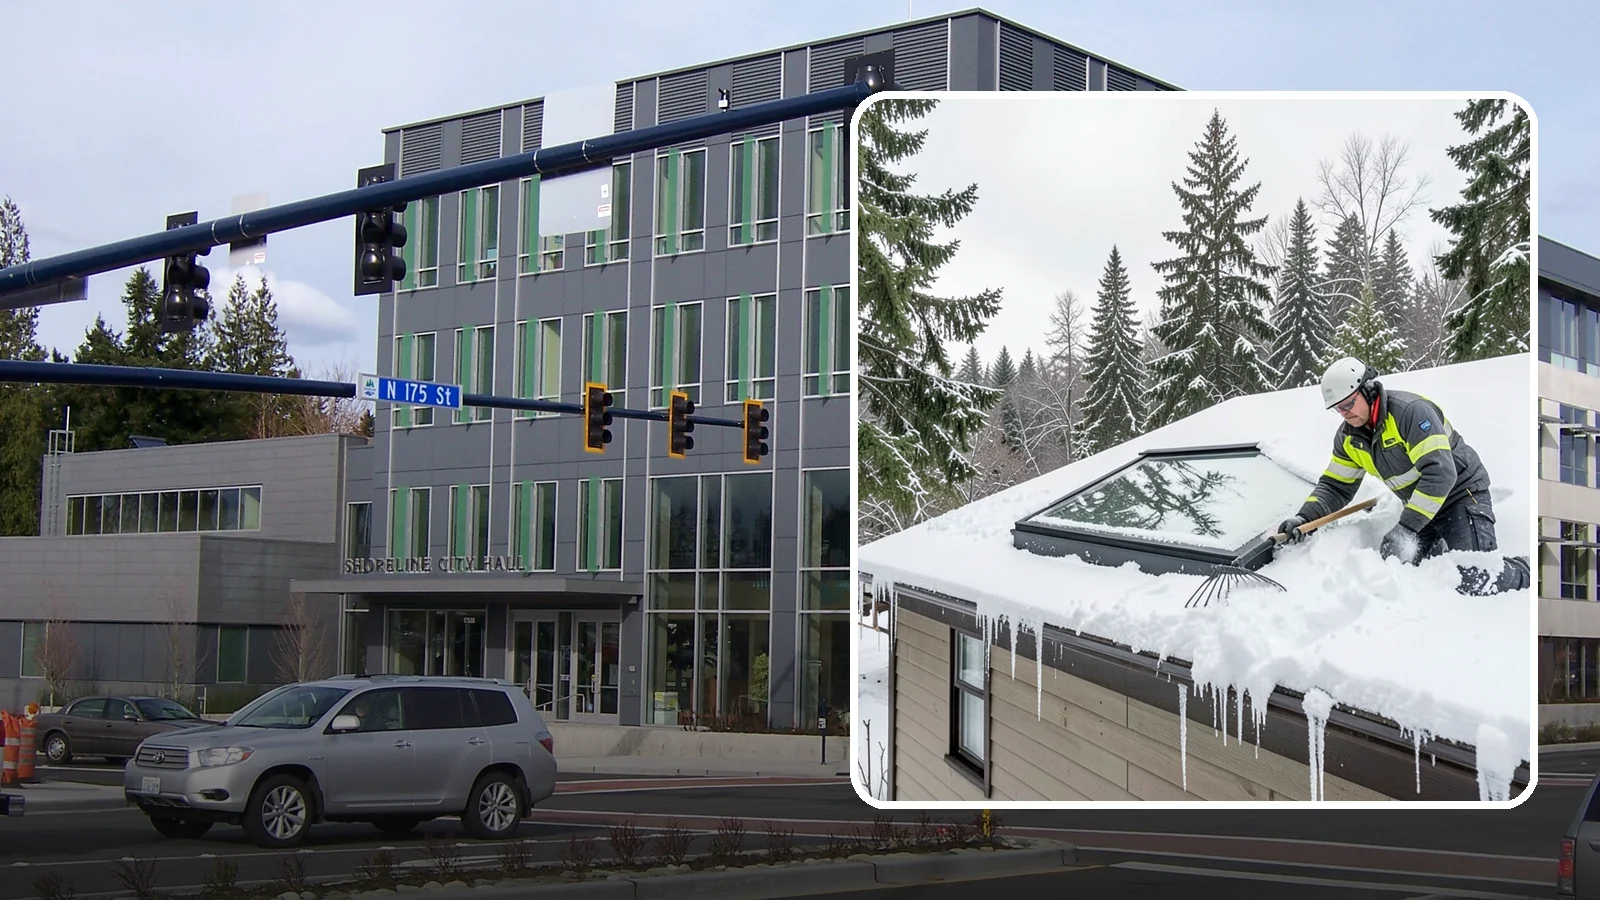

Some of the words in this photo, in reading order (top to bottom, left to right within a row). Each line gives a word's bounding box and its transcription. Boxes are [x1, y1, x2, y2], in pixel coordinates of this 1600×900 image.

[387, 380, 396, 400] N
[405, 382, 428, 403] 175
[436, 385, 451, 406] St
[344, 556, 432, 574] SHORELINE
[438, 555, 476, 573] CITY
[483, 555, 525, 572] HALL
